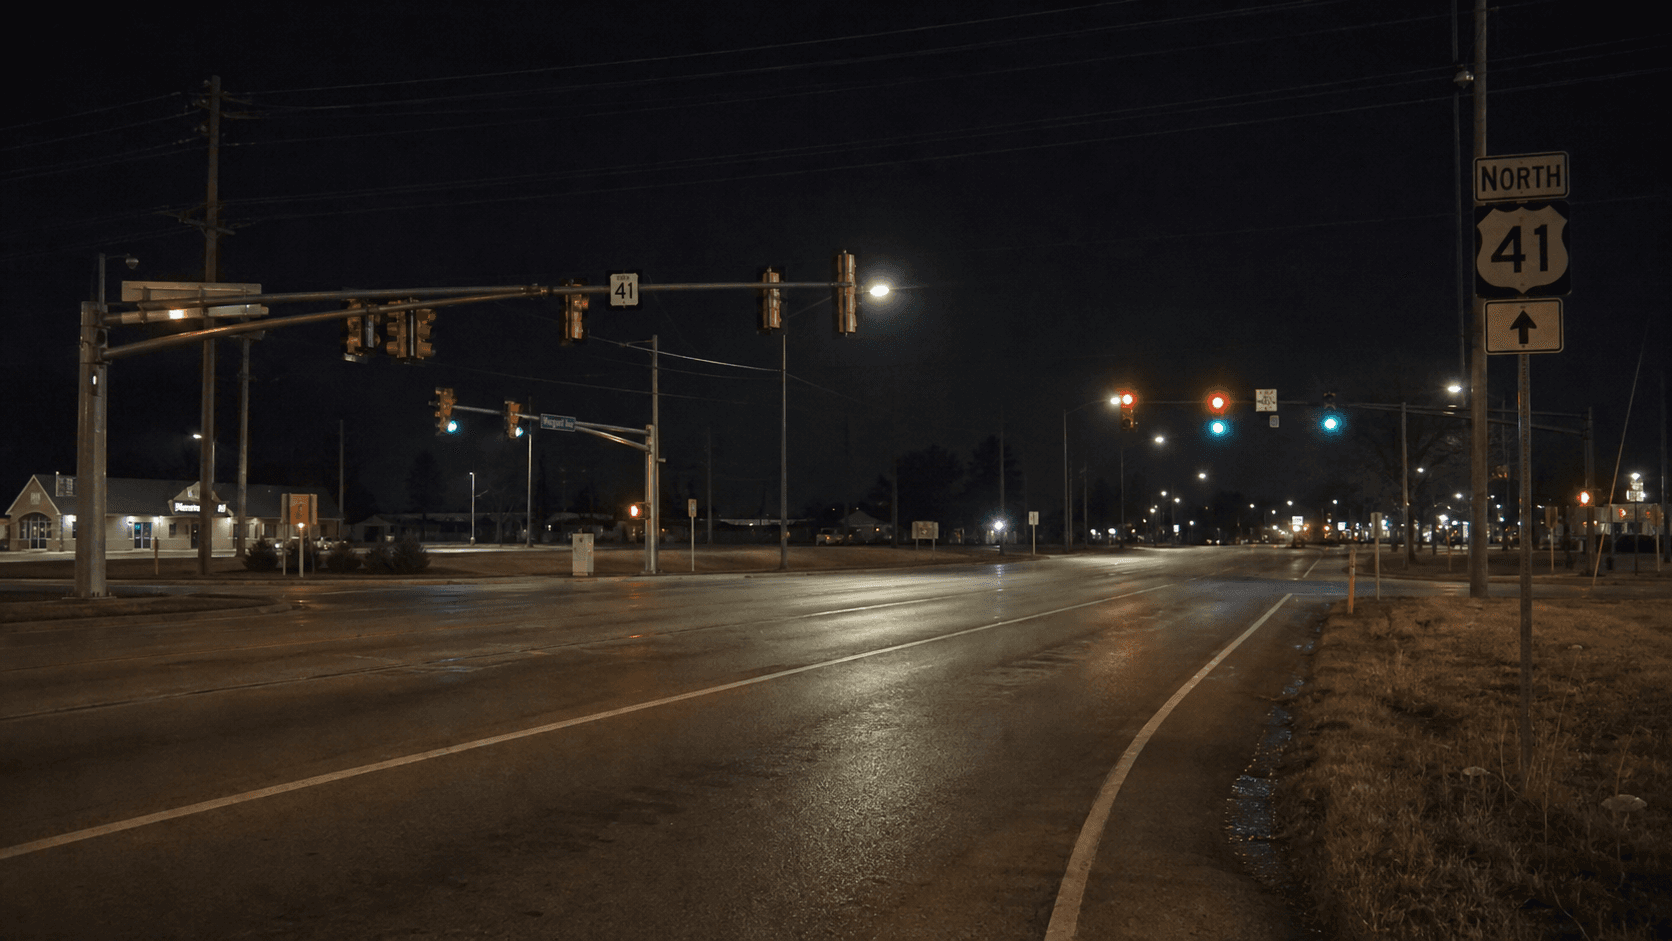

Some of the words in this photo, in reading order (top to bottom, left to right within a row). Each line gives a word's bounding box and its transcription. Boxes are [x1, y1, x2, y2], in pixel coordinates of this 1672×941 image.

[1481, 164, 1561, 192] NORTH
[1490, 224, 1549, 274] 41
[614, 281, 634, 300] 41
